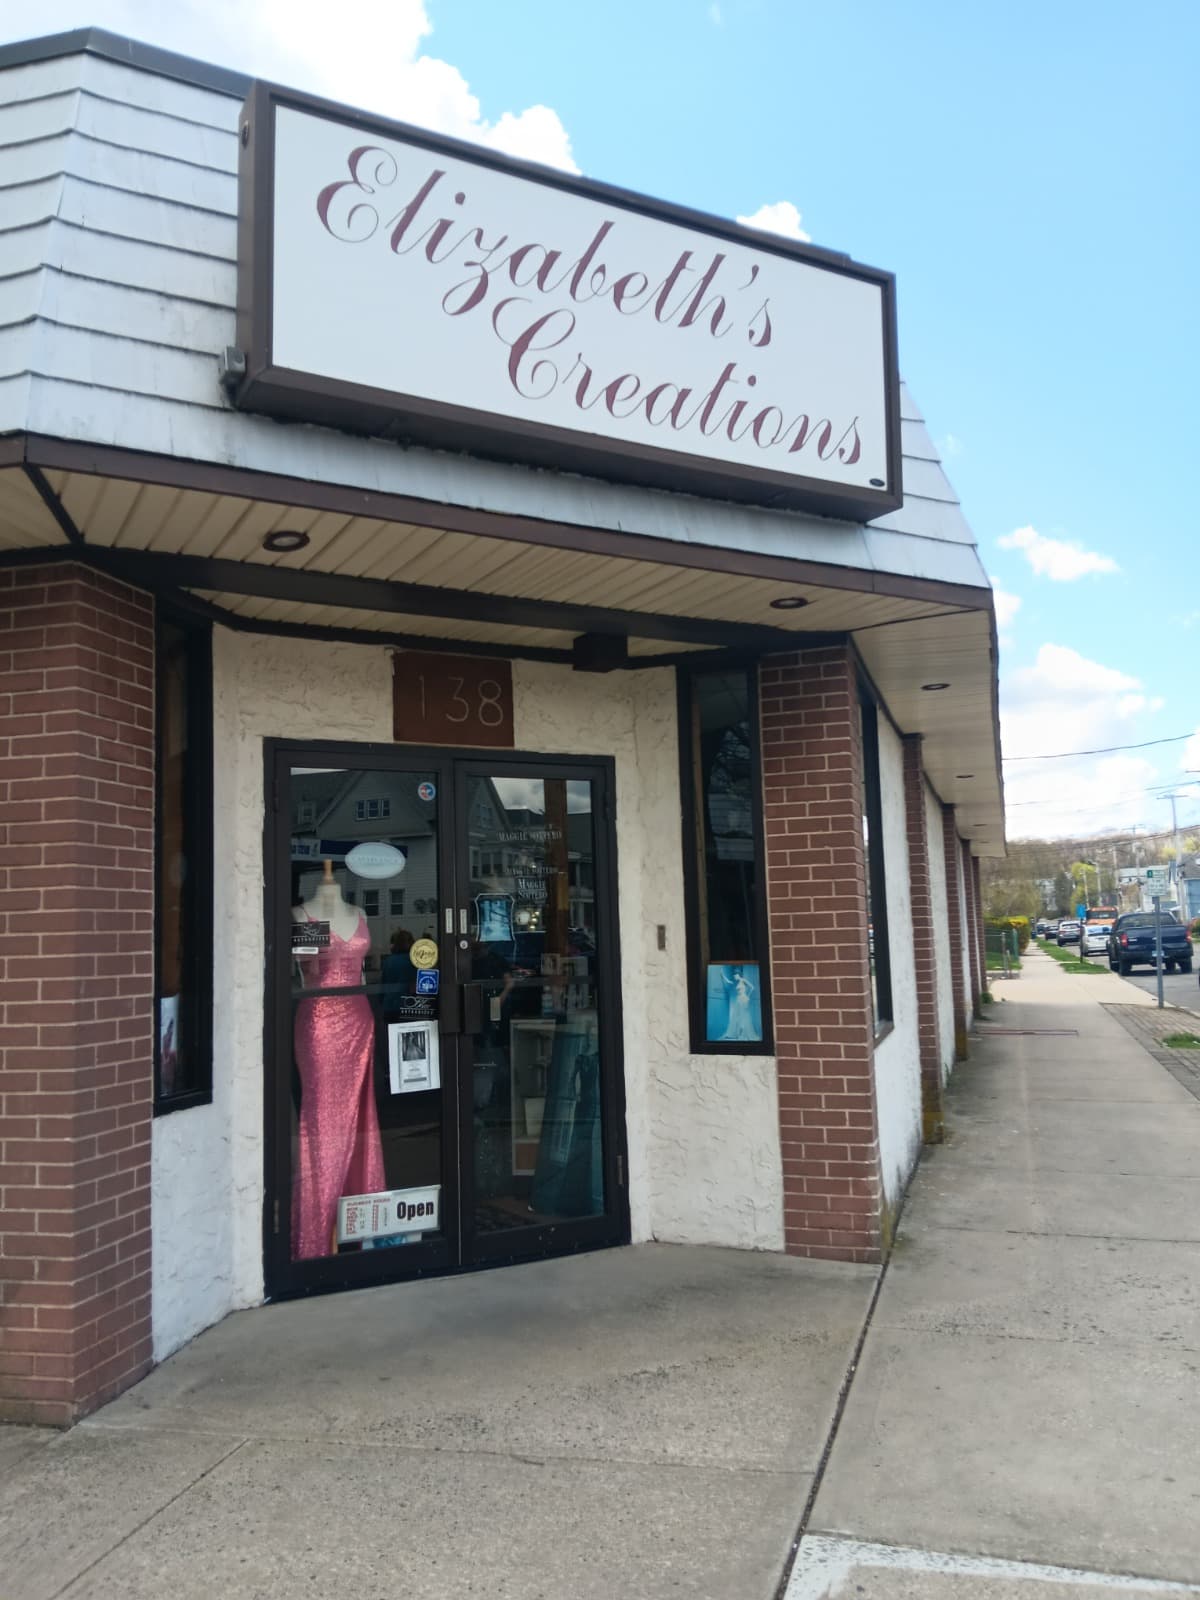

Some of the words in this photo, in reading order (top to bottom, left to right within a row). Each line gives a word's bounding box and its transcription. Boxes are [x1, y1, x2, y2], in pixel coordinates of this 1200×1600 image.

[316, 145, 772, 347] Elizabeth's
[491, 296, 861, 465] Creations
[419, 675, 503, 726] 138
[397, 1201, 434, 1221] Open
